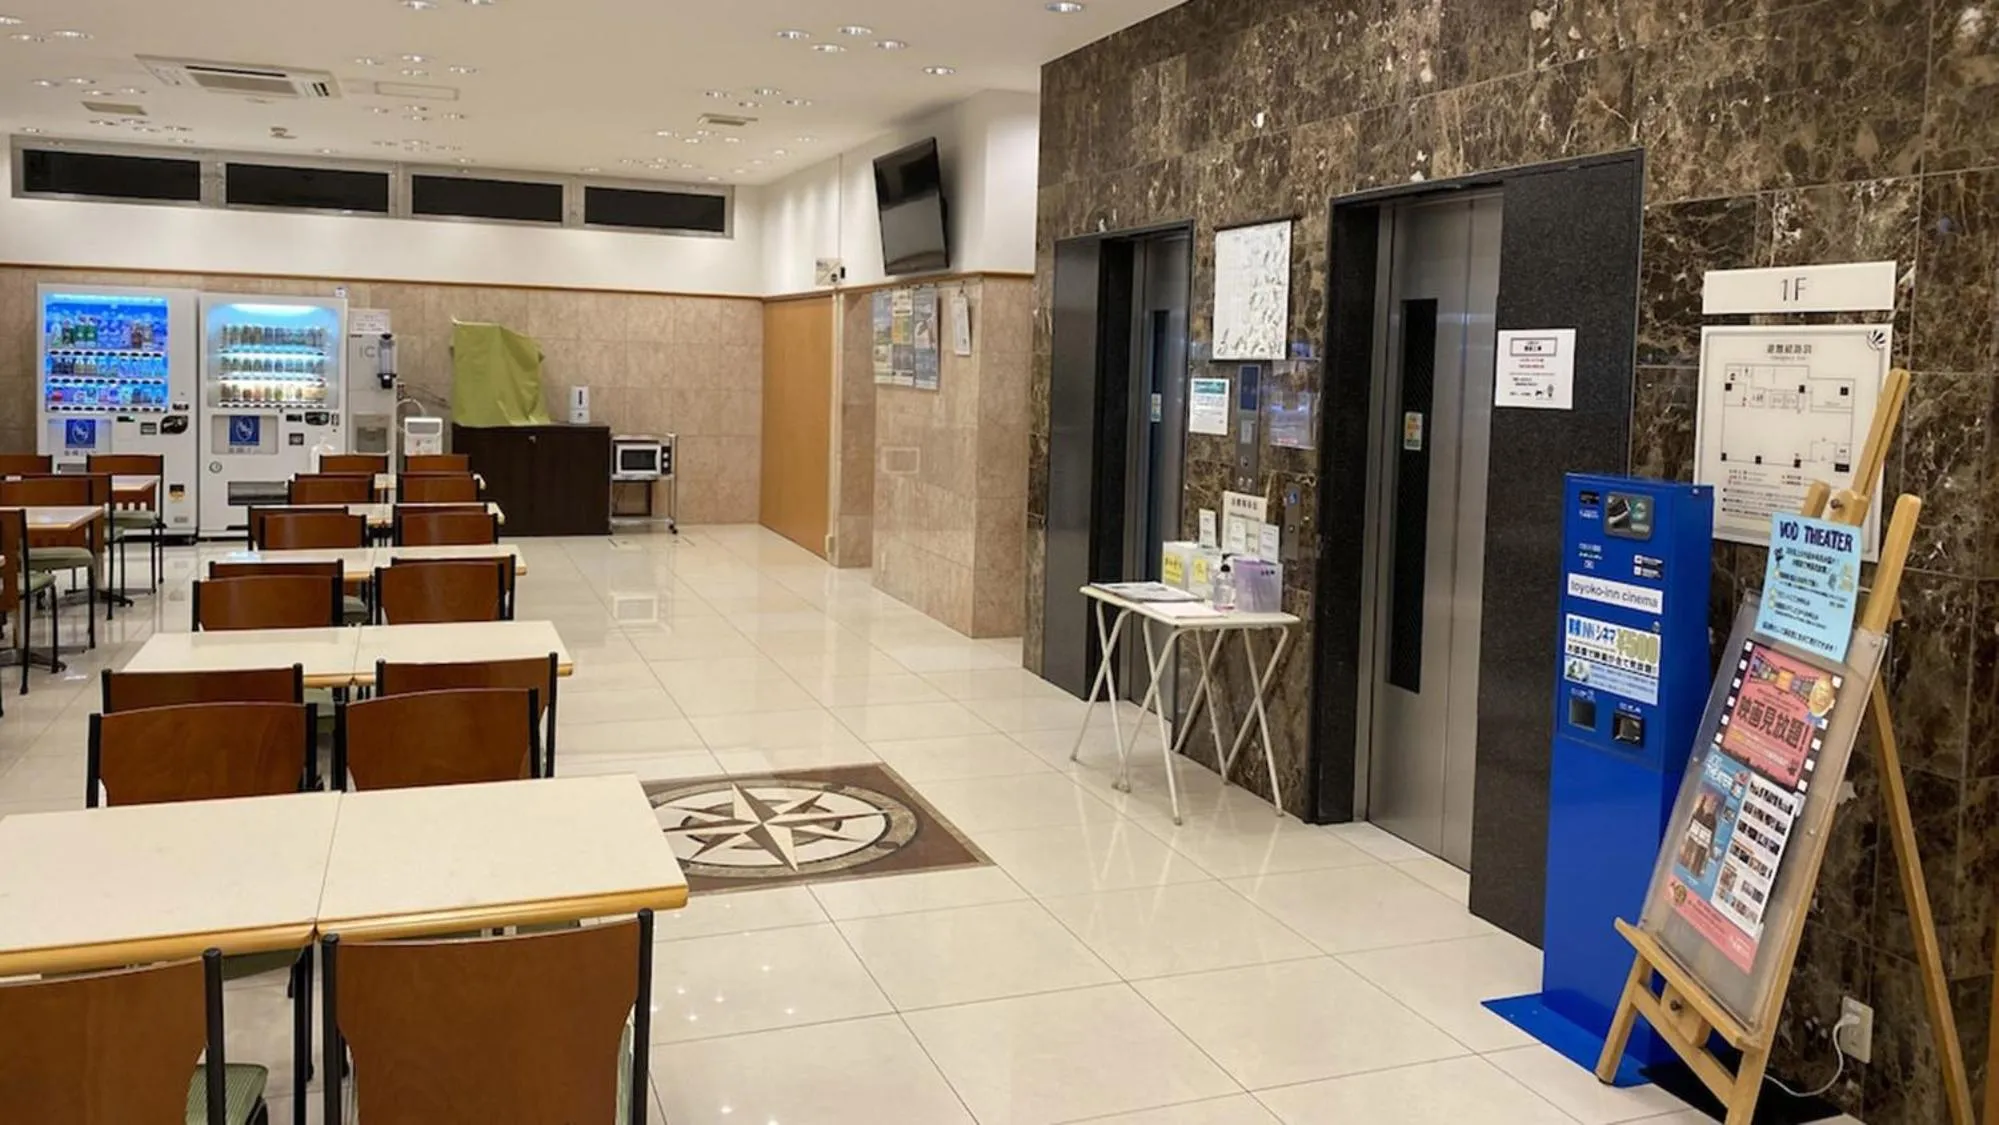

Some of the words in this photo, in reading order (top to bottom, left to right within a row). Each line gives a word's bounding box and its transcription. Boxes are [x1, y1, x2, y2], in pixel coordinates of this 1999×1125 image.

[1780, 275, 1808, 302] 1F
[1780, 520, 1799, 541] VOD
[1804, 525, 1853, 553] THEATER
[1570, 579, 1621, 601] toyoko-inn
[1622, 590, 1659, 608] cinema
